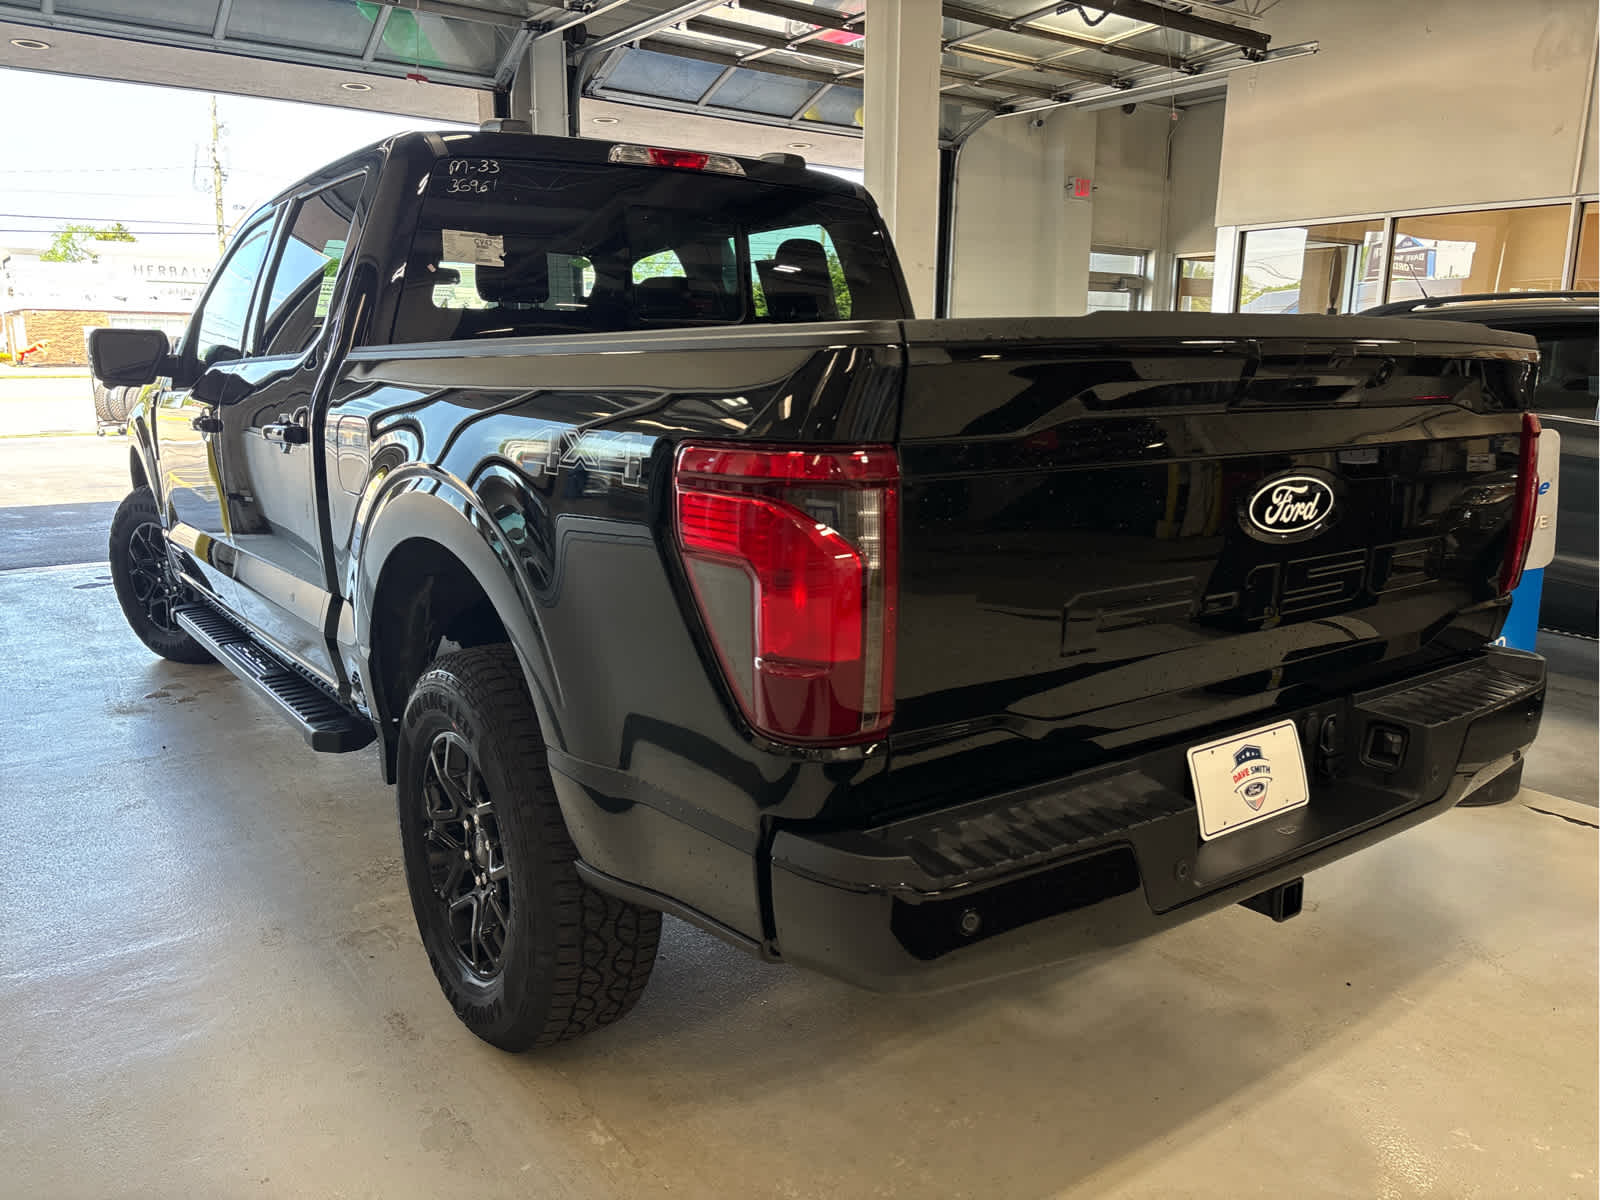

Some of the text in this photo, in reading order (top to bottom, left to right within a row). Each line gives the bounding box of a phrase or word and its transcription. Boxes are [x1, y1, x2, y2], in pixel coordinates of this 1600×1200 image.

[1265, 486, 1321, 525] Ford
[1233, 765, 1271, 784] DAVE SMITH
